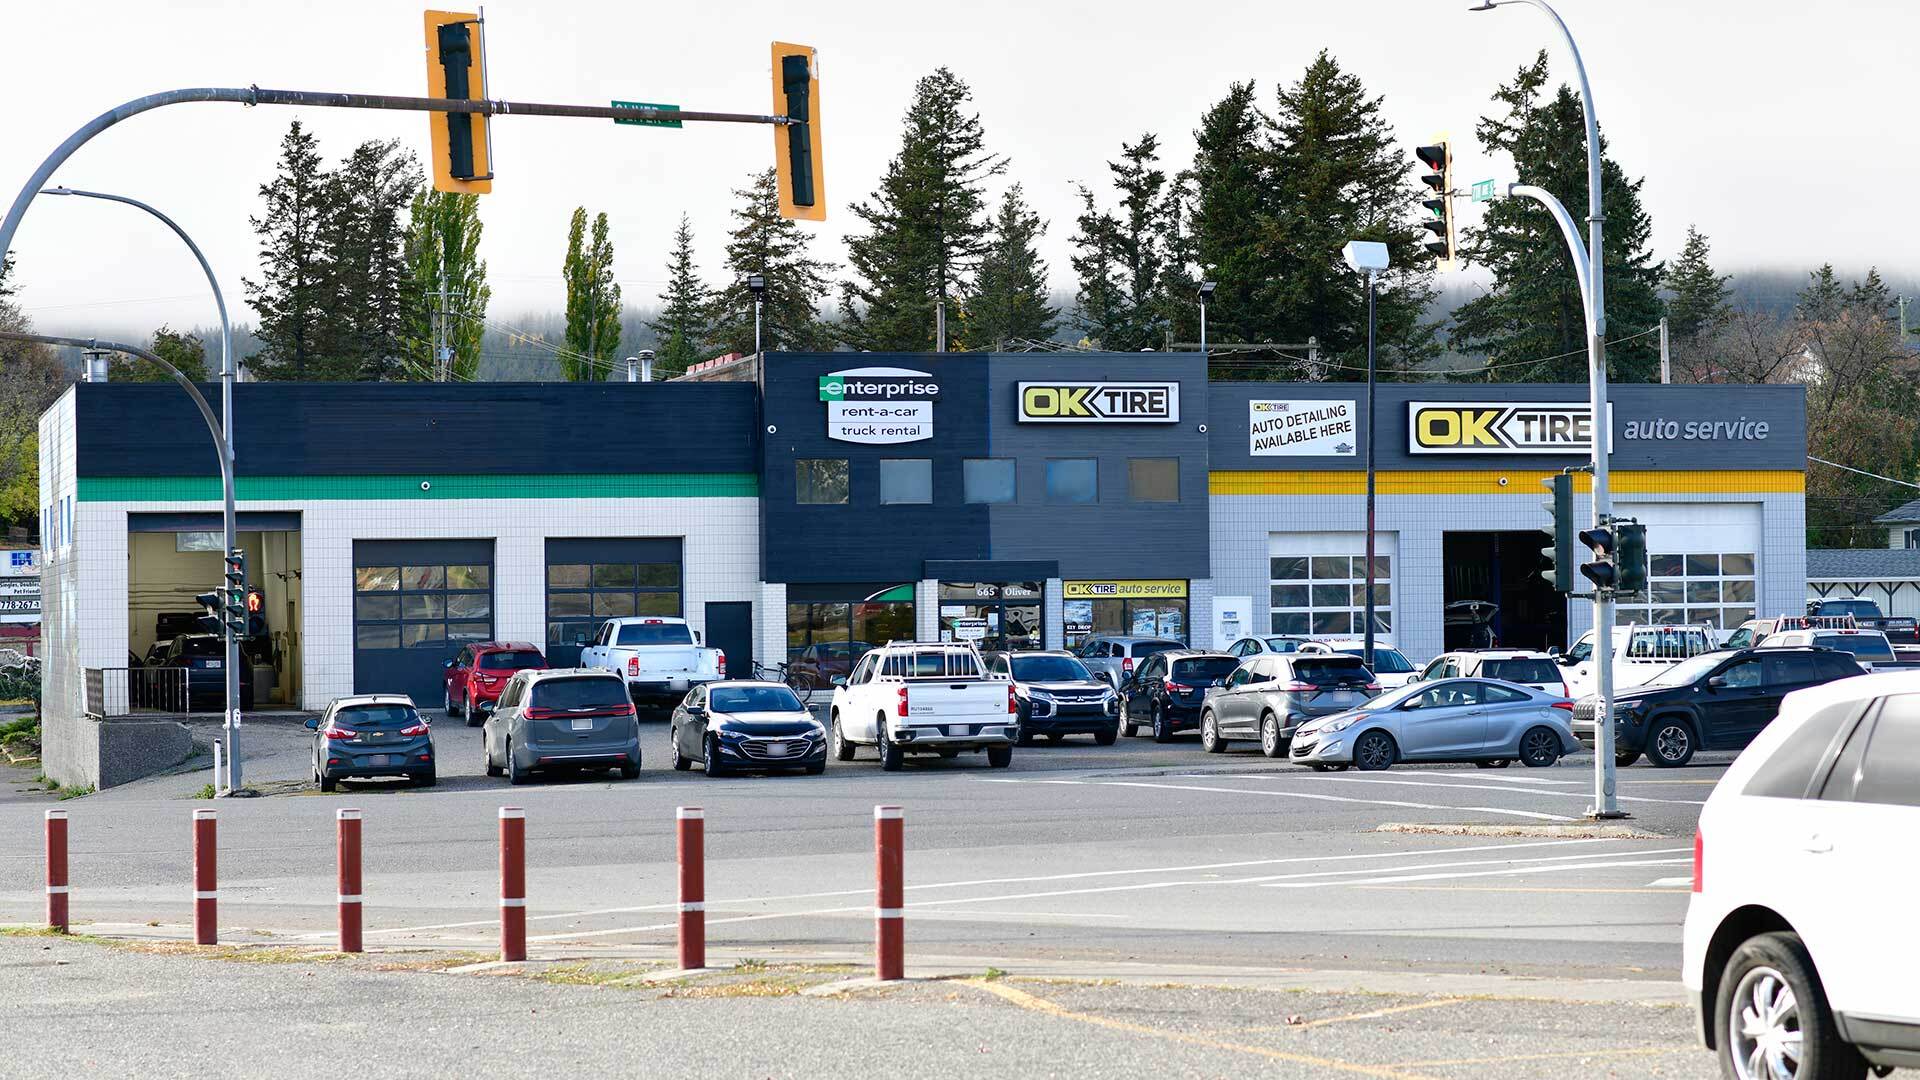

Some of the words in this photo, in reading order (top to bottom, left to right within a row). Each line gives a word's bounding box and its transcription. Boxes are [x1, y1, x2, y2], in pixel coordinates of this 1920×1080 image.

[820, 380, 939, 398] enterprise
[842, 407, 919, 417] rent-a-car
[1024, 387, 1092, 416] OK
[1103, 391, 1165, 413] TIRE
[841, 425, 876, 436] truck
[881, 425, 920, 436] rental
[1252, 418, 1284, 435] AUTO
[1286, 405, 1347, 428] DETAILING
[1418, 410, 1499, 446] OK
[1517, 415, 1592, 442] TIRE
[1623, 418, 1678, 440] auto
[1682, 416, 1769, 440] service
[1254, 427, 1318, 451] AVAILABLE
[1320, 420, 1352, 438] HERE
[977, 588, 995, 597] 665
[1004, 588, 1032, 596] Oliver
[1067, 584, 1091, 594] OK
[1095, 585, 1115, 593] TIRE
[1119, 585, 1142, 594] auto
[1144, 584, 1181, 594] service
